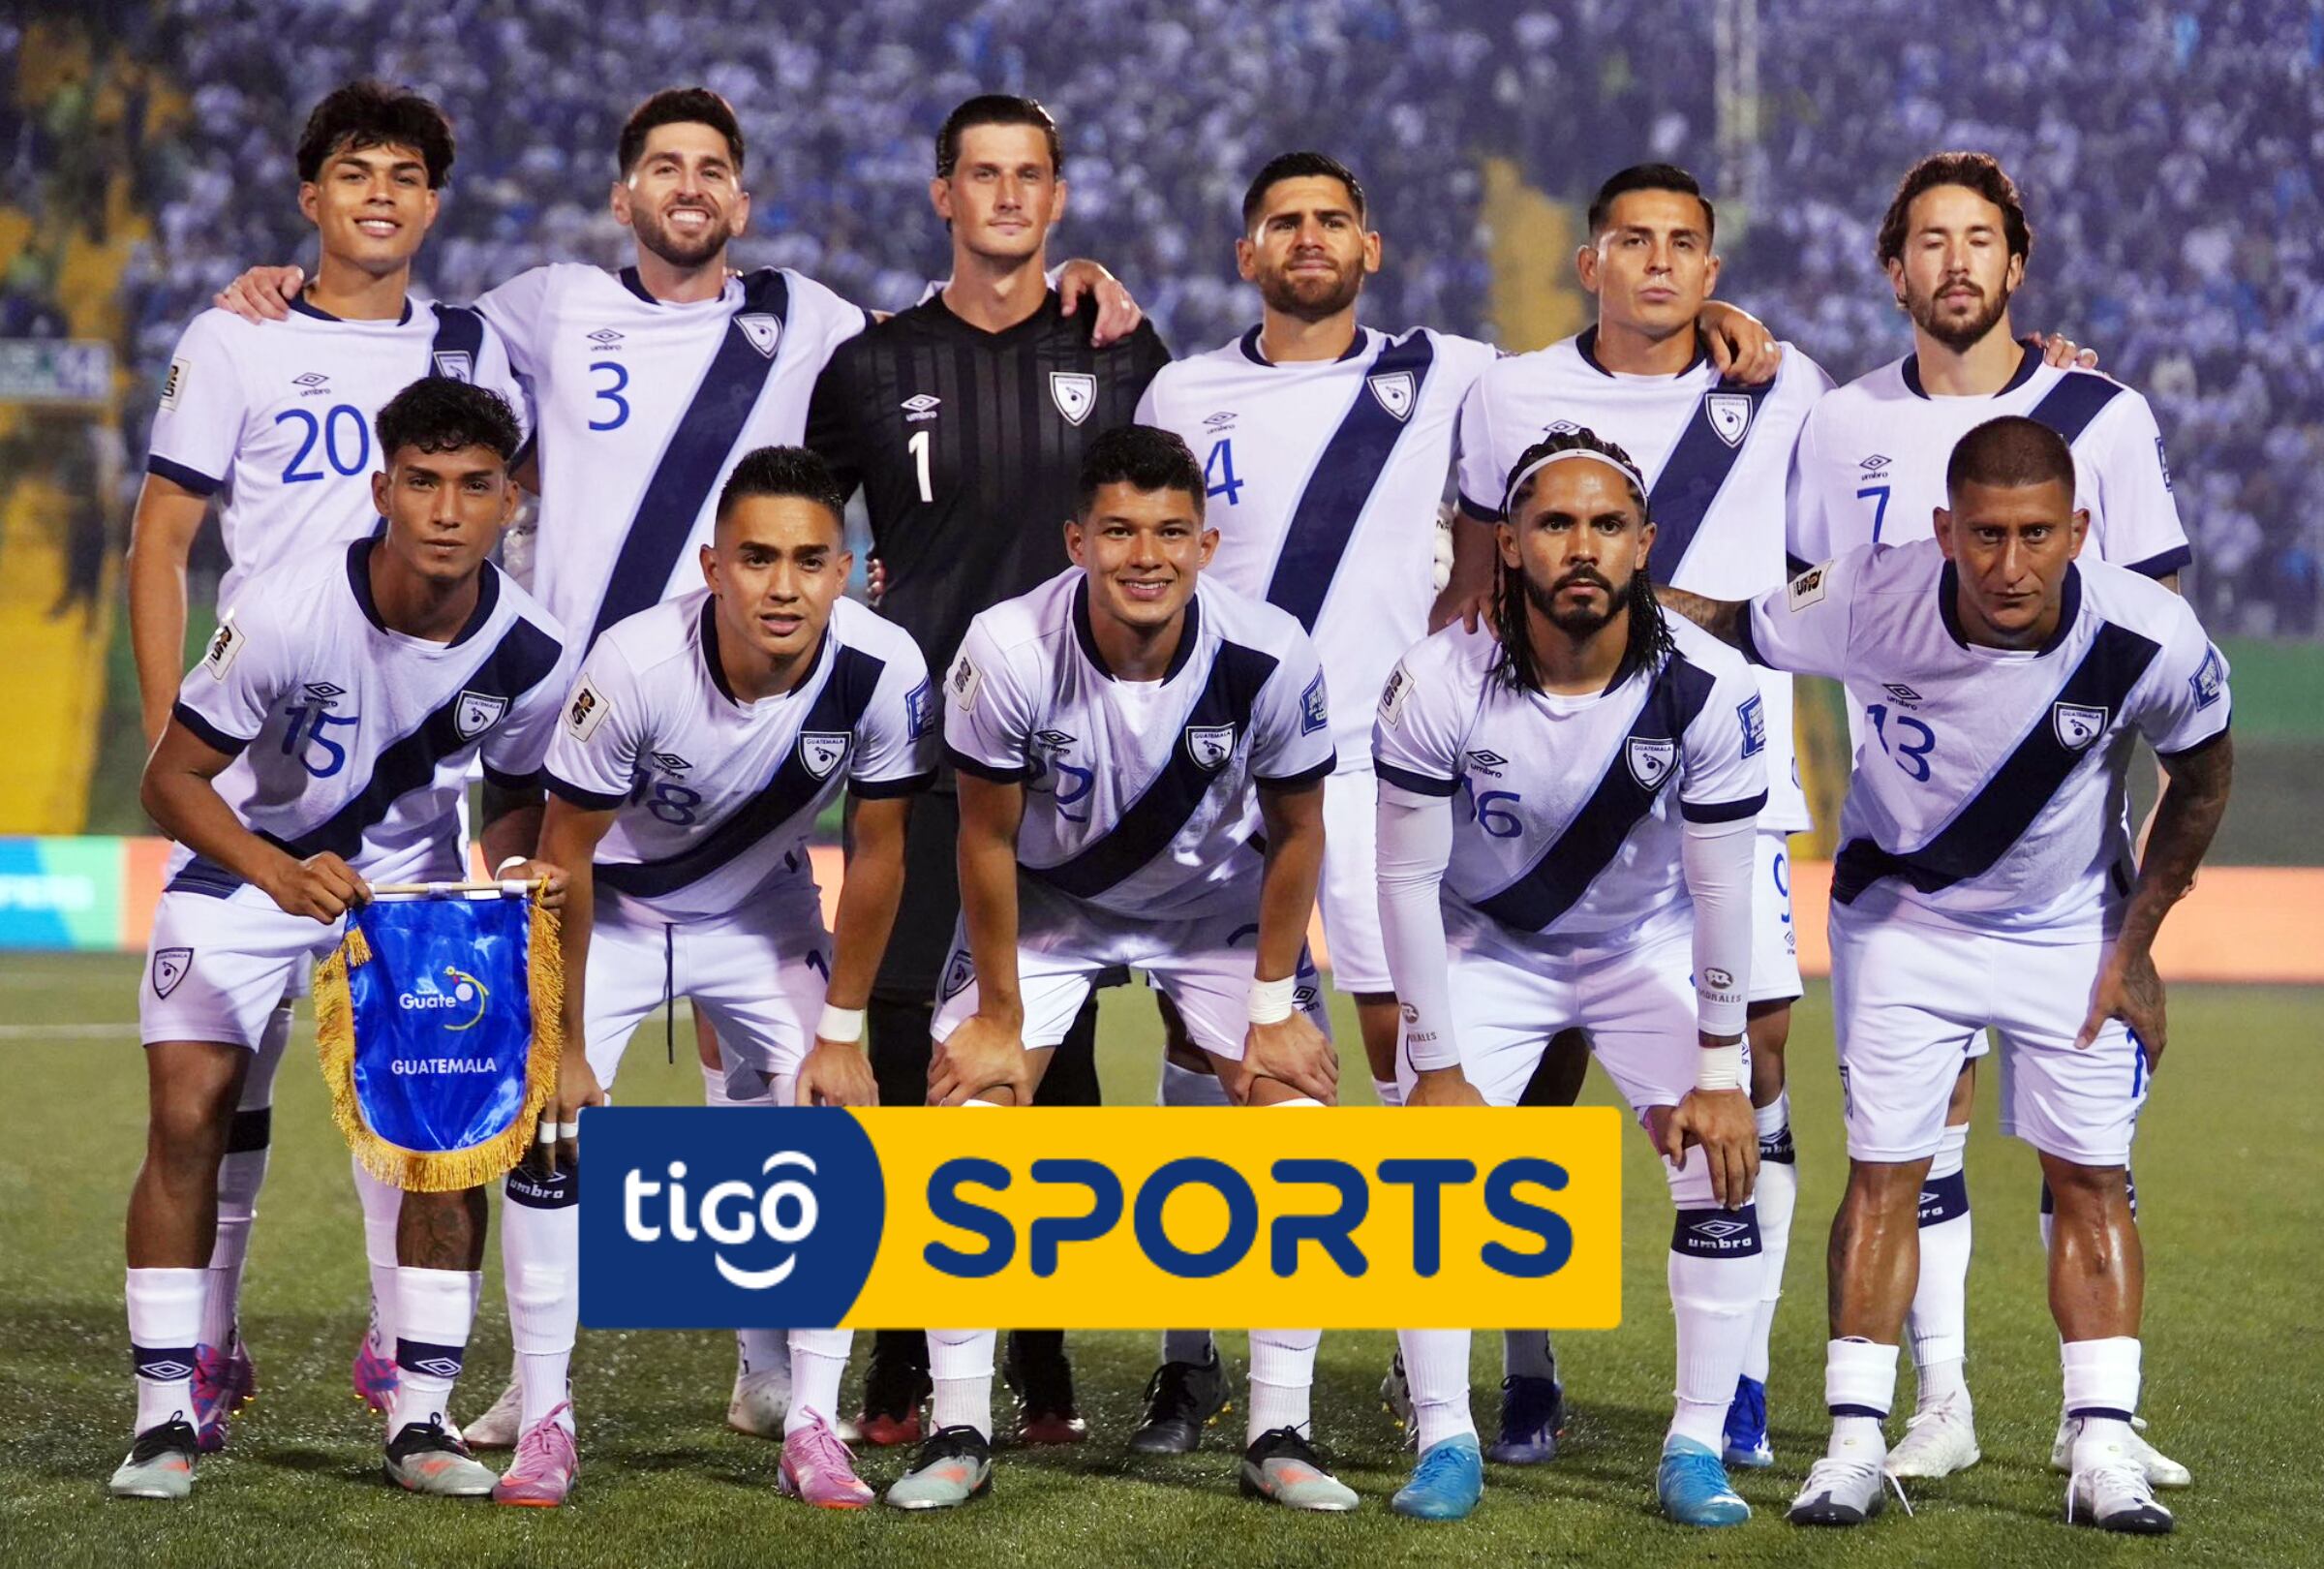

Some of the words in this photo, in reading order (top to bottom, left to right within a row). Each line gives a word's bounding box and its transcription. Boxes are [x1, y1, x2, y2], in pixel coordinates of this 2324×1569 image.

[300, 388, 331, 397] umbro
[587, 361, 630, 431] 3
[274, 404, 370, 484] 20
[907, 430, 933, 503] 1
[1206, 438, 1244, 506] 4
[1861, 472, 1888, 480] umbro
[1856, 485, 1891, 542] 7
[466, 698, 502, 710] GUATEMALA
[1885, 694, 1918, 711] umbro
[2062, 711, 2100, 720] GUATEMALA
[280, 705, 359, 779] 15
[1194, 730, 1232, 739] GUATEMALA
[1866, 703, 1936, 783] 13
[1634, 744, 1673, 753] GUATEMALA
[652, 761, 686, 780] umbro
[1470, 762, 1503, 779] umbro
[629, 767, 702, 826] 18
[1460, 772, 1523, 839] 16
[399, 993, 456, 1009] Guate
[391, 1058, 497, 1075] GUATEMALA
[509, 1178, 566, 1199] umbro
[1687, 1238, 1752, 1250] umbro
